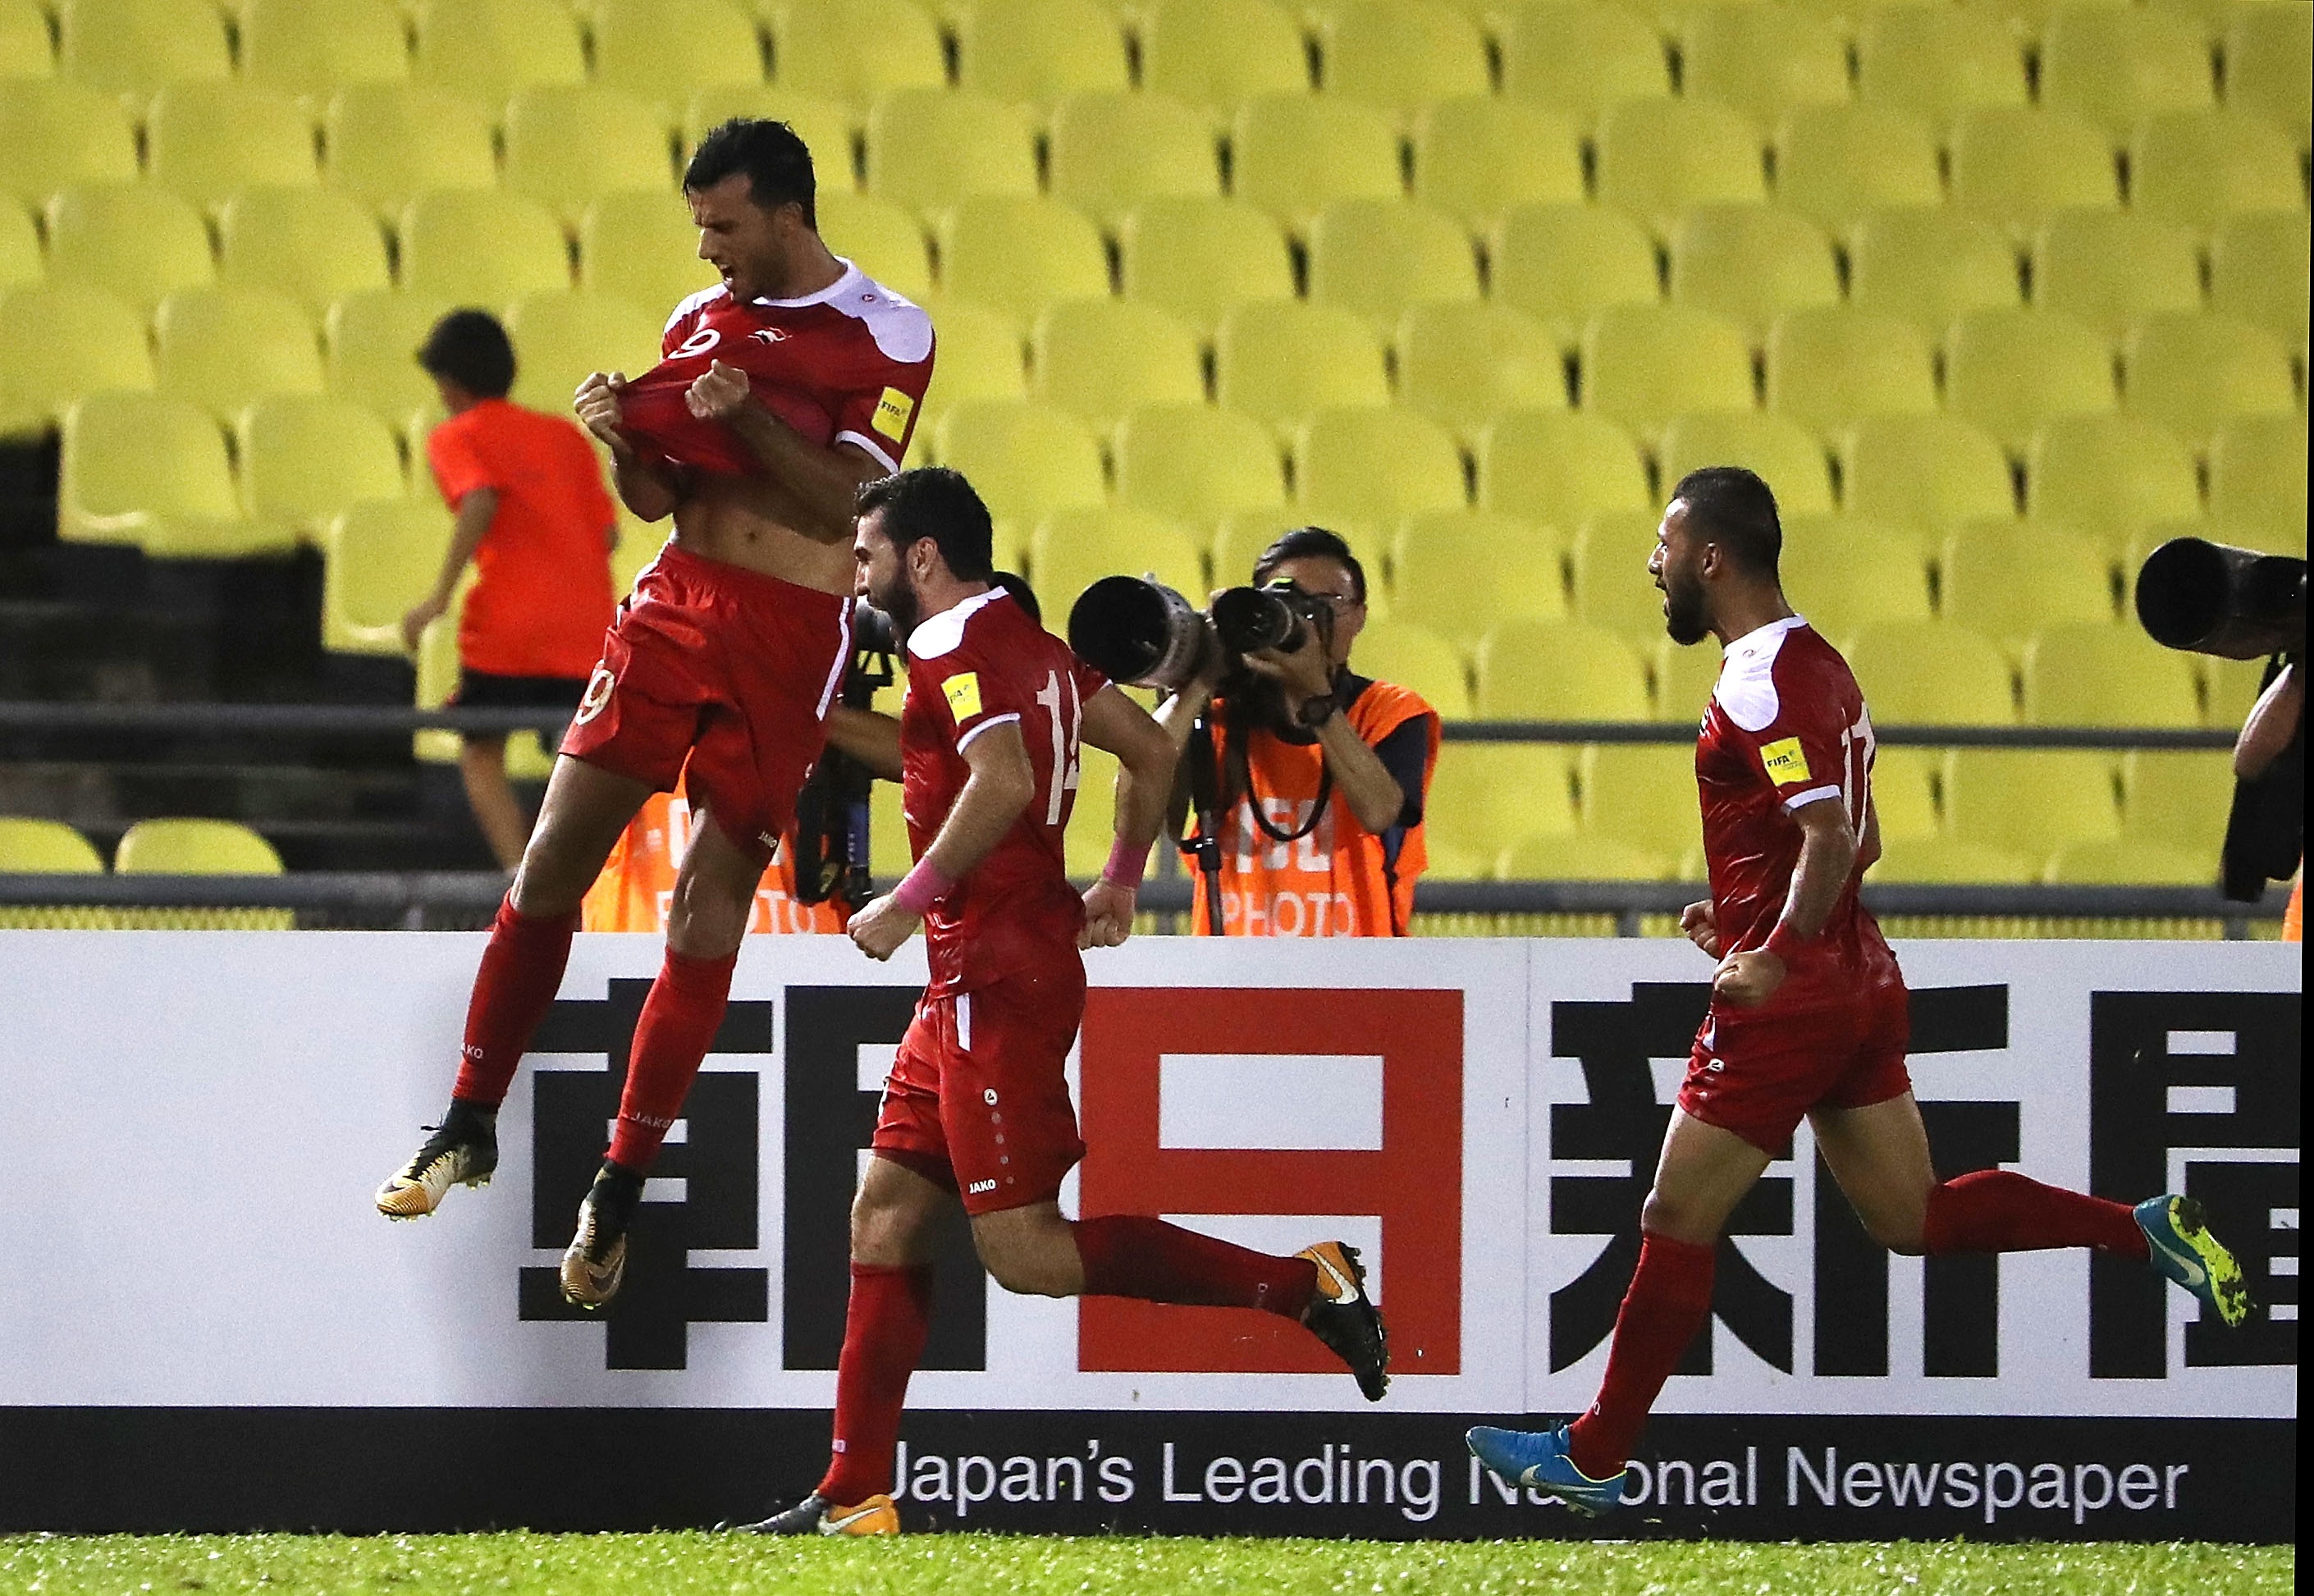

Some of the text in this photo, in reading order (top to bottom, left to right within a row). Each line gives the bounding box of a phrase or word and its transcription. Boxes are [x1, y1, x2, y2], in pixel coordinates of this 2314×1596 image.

[667, 328, 720, 359] 9
[575, 668, 615, 726] 9
[1767, 755, 1790, 767] FIFA
[1841, 701, 1876, 848] 17
[1221, 890, 1355, 937] PHOTO
[969, 1178, 996, 1195] JAKO
[890, 1438, 1136, 1517] Japan’s
[1163, 1442, 1442, 1522] Leading
[1786, 1446, 2189, 1525] Newspaper
